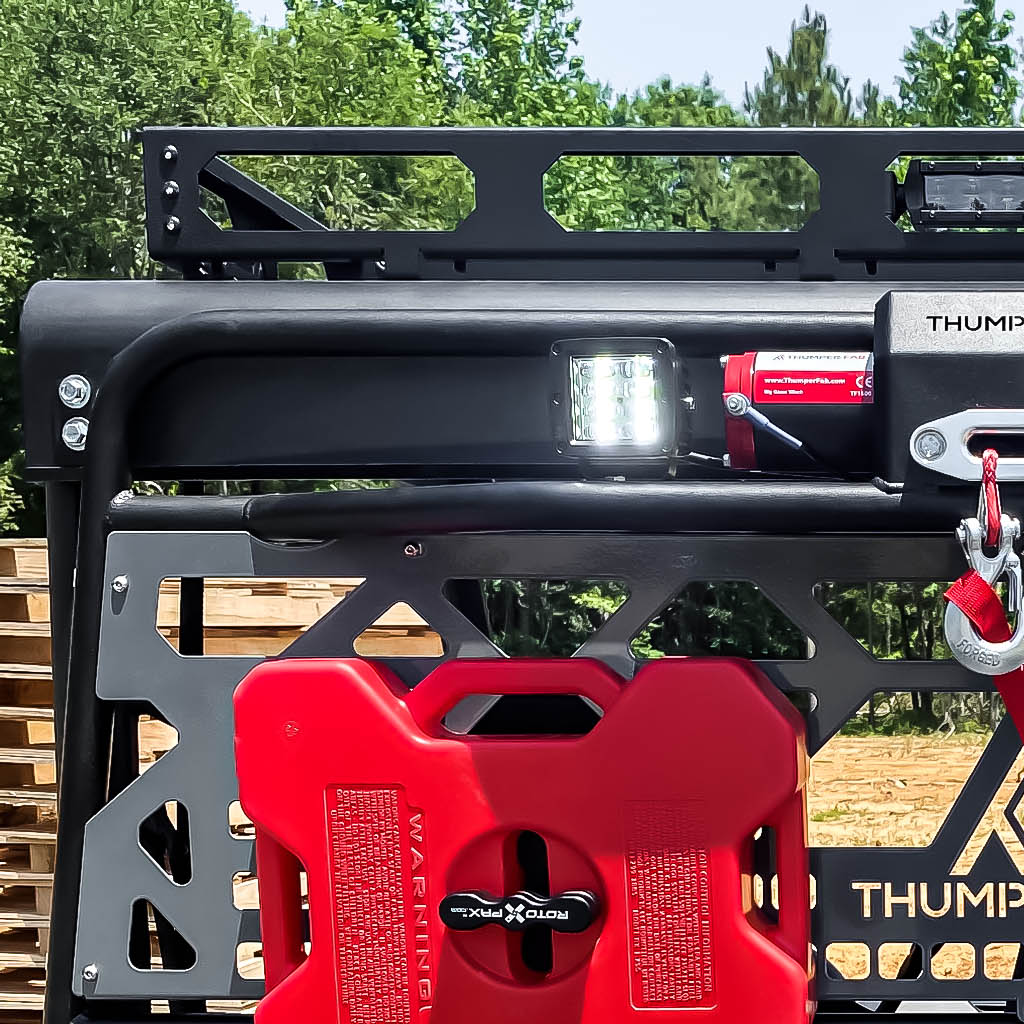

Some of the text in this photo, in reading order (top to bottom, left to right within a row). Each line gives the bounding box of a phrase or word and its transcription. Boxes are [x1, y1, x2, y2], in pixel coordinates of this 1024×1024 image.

[764, 377, 845, 386] www.ThumperFab.com
[957, 639, 1000, 666] FORGED
[409, 814, 431, 1000] WARNING
